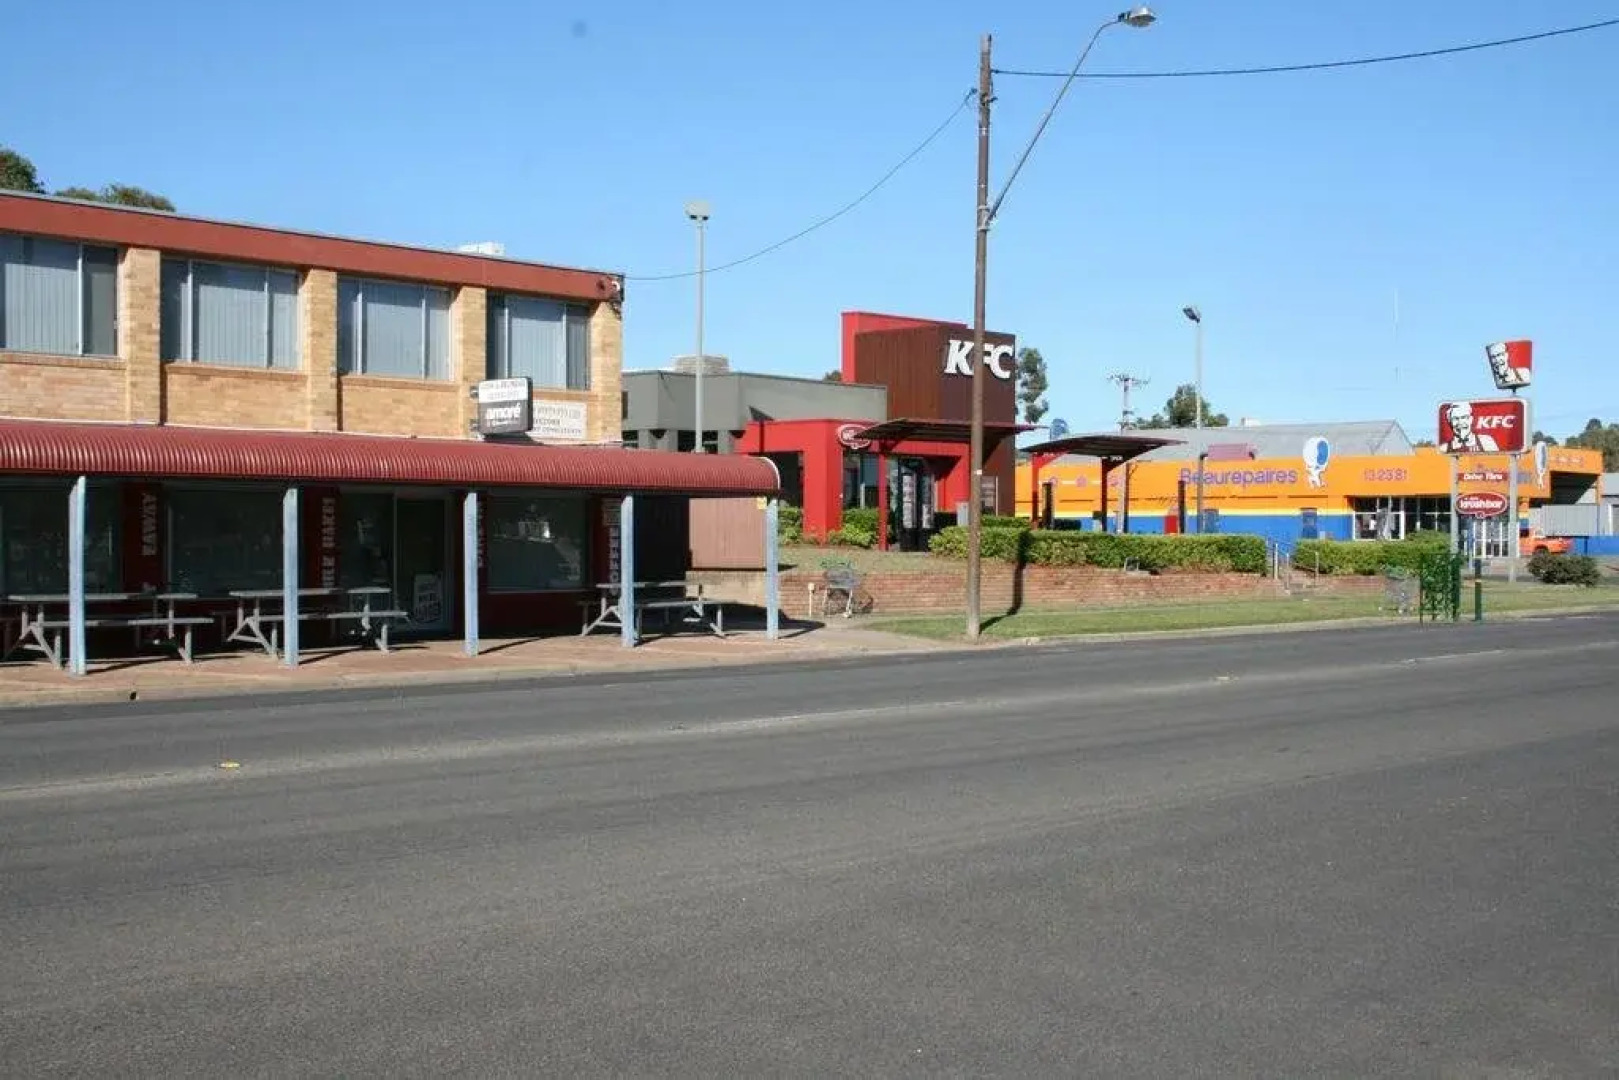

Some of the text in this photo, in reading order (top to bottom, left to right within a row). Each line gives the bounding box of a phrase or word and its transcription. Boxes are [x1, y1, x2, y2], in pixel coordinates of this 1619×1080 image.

[944, 339, 1014, 379] KFC
[1476, 415, 1515, 429] KFC
[1181, 468, 1298, 488] Beaurepaires
